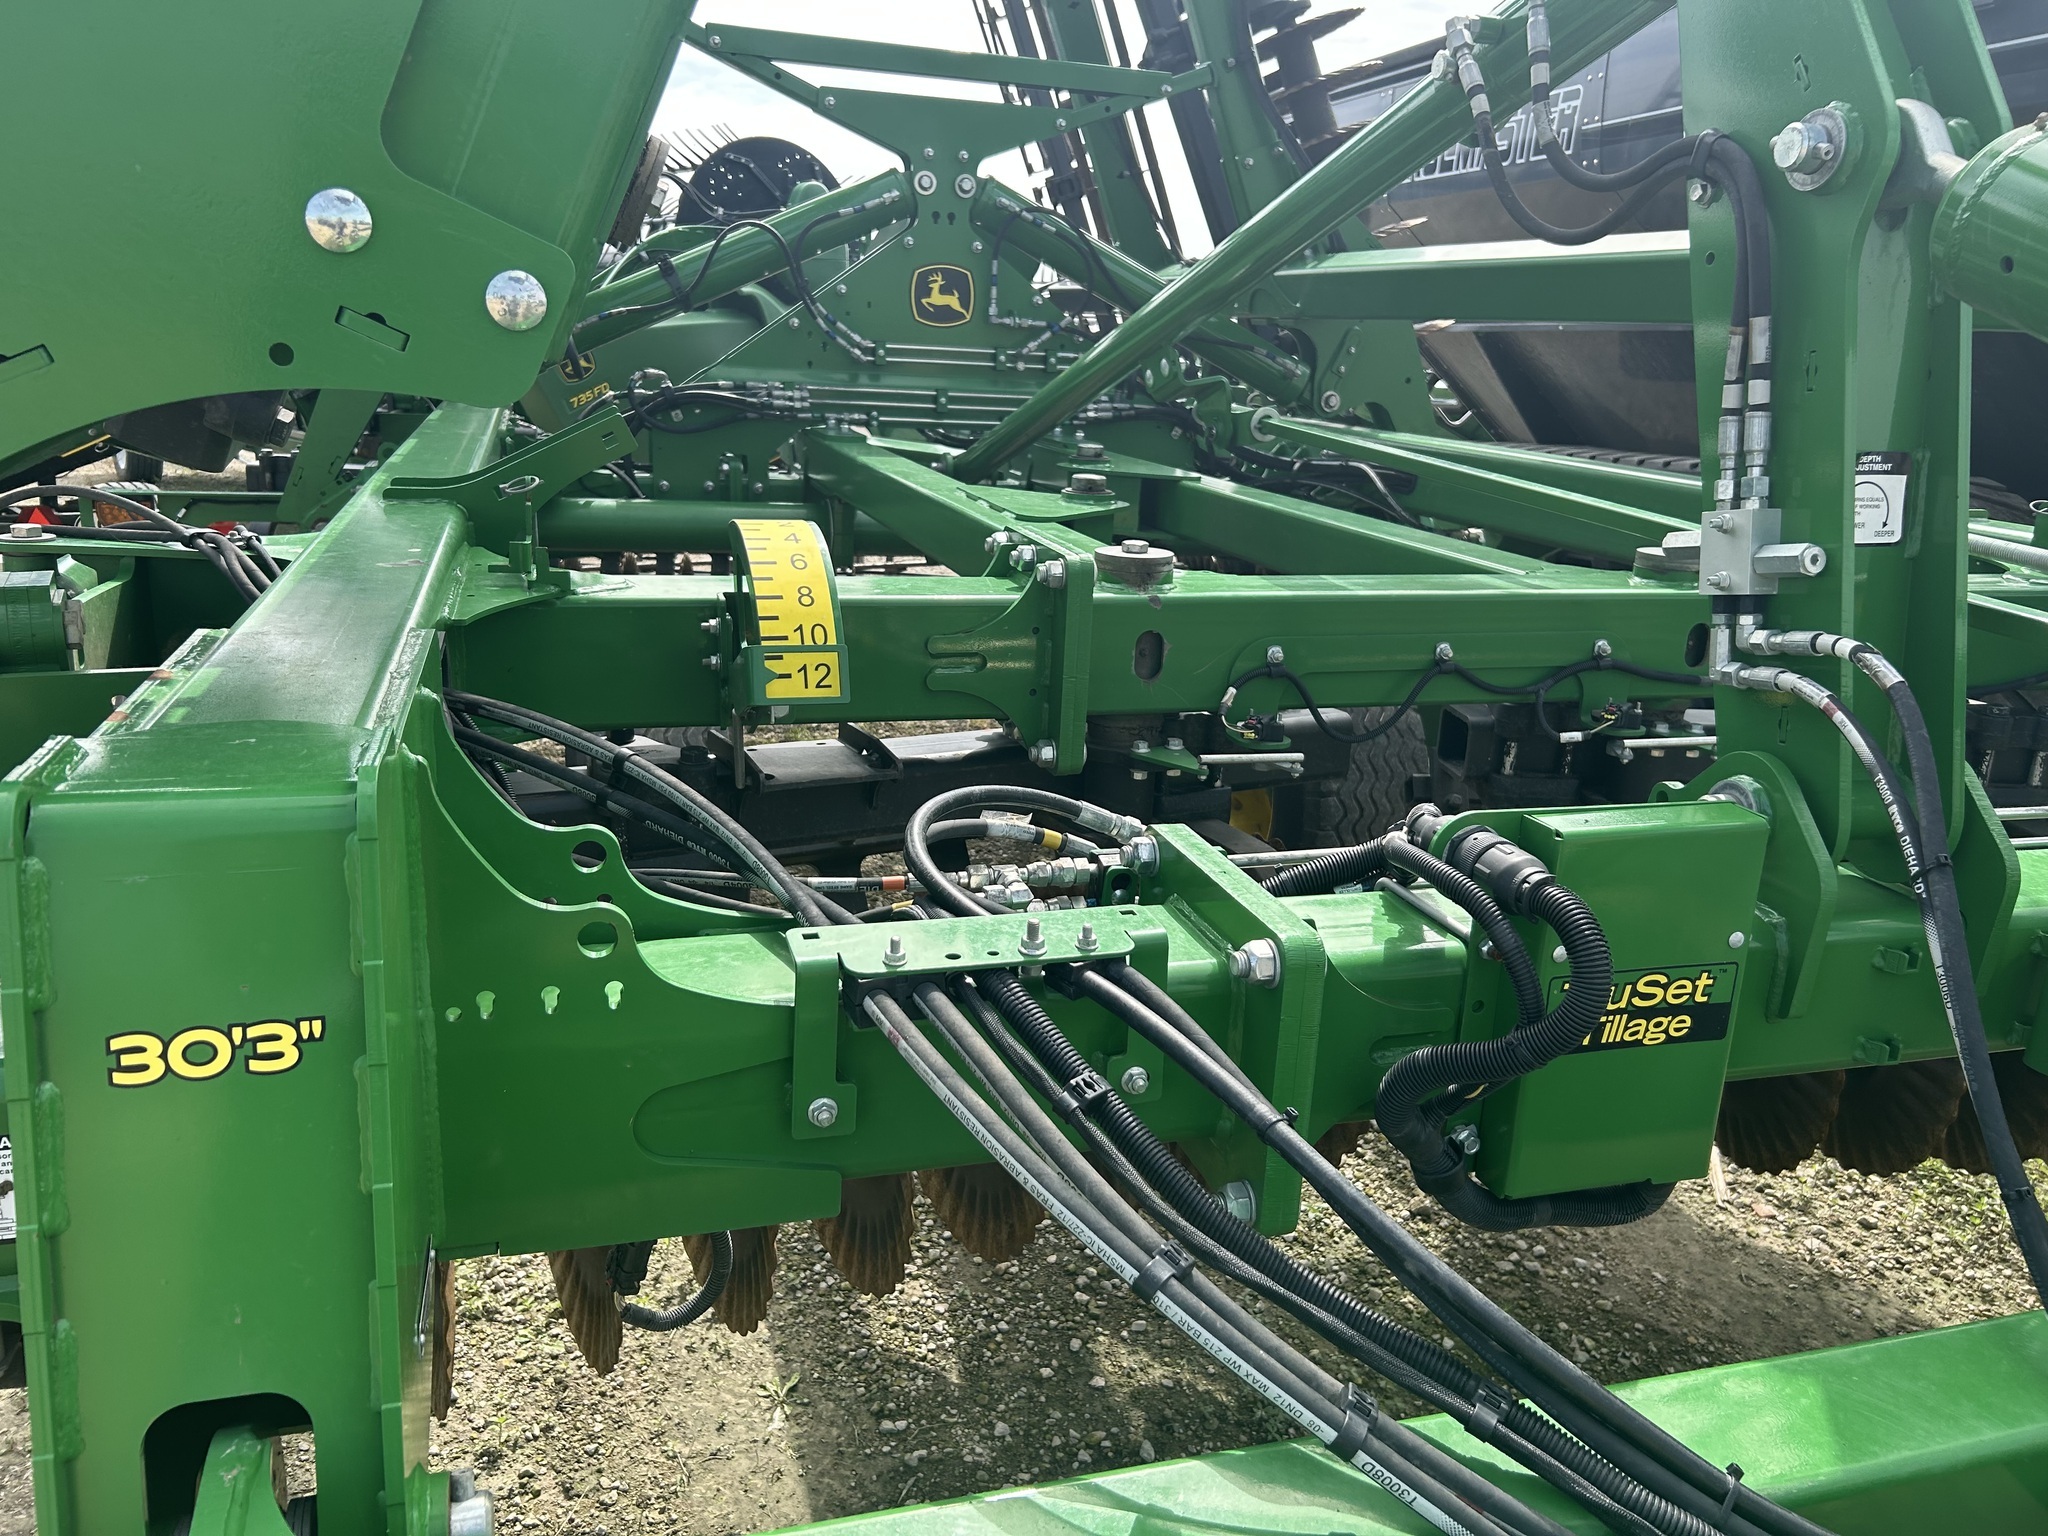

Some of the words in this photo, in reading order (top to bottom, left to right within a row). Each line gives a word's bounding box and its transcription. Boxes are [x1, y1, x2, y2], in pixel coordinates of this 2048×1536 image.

[1855, 463, 1892, 471] JUSTMENT
[1859, 455, 1881, 463] DEPTH
[784, 532, 801, 544] 4
[790, 553, 808, 570] 6
[797, 586, 815, 607] 8
[793, 623, 828, 645] 10
[797, 662, 832, 689] 12
[527, 720, 562, 739] RESISTANT
[561, 734, 594, 752] ABRASION
[1870, 772, 1894, 805] T3000
[106, 1016, 326, 1088] 30'3"
[940, 1092, 982, 1136] RESISTANT
[978, 1132, 1022, 1178] ABRASION
[1027, 1183, 1055, 1209] FRAS
[1055, 1208, 1097, 1247] IC-227/12
[1094, 1243, 1126, 1273] MSHA
[1149, 1293, 1173, 1314] 310
[1175, 1315, 1203, 1339] BAR
[1201, 1336, 1223, 1356] 215
[1221, 1352, 1244, 1372] WP
[1241, 1368, 1270, 1393] MAX
[1271, 1392, 1304, 1419] DN12
[1305, 1418, 1325, 1436] -08
[1359, 1458, 1420, 1507] T3008D
